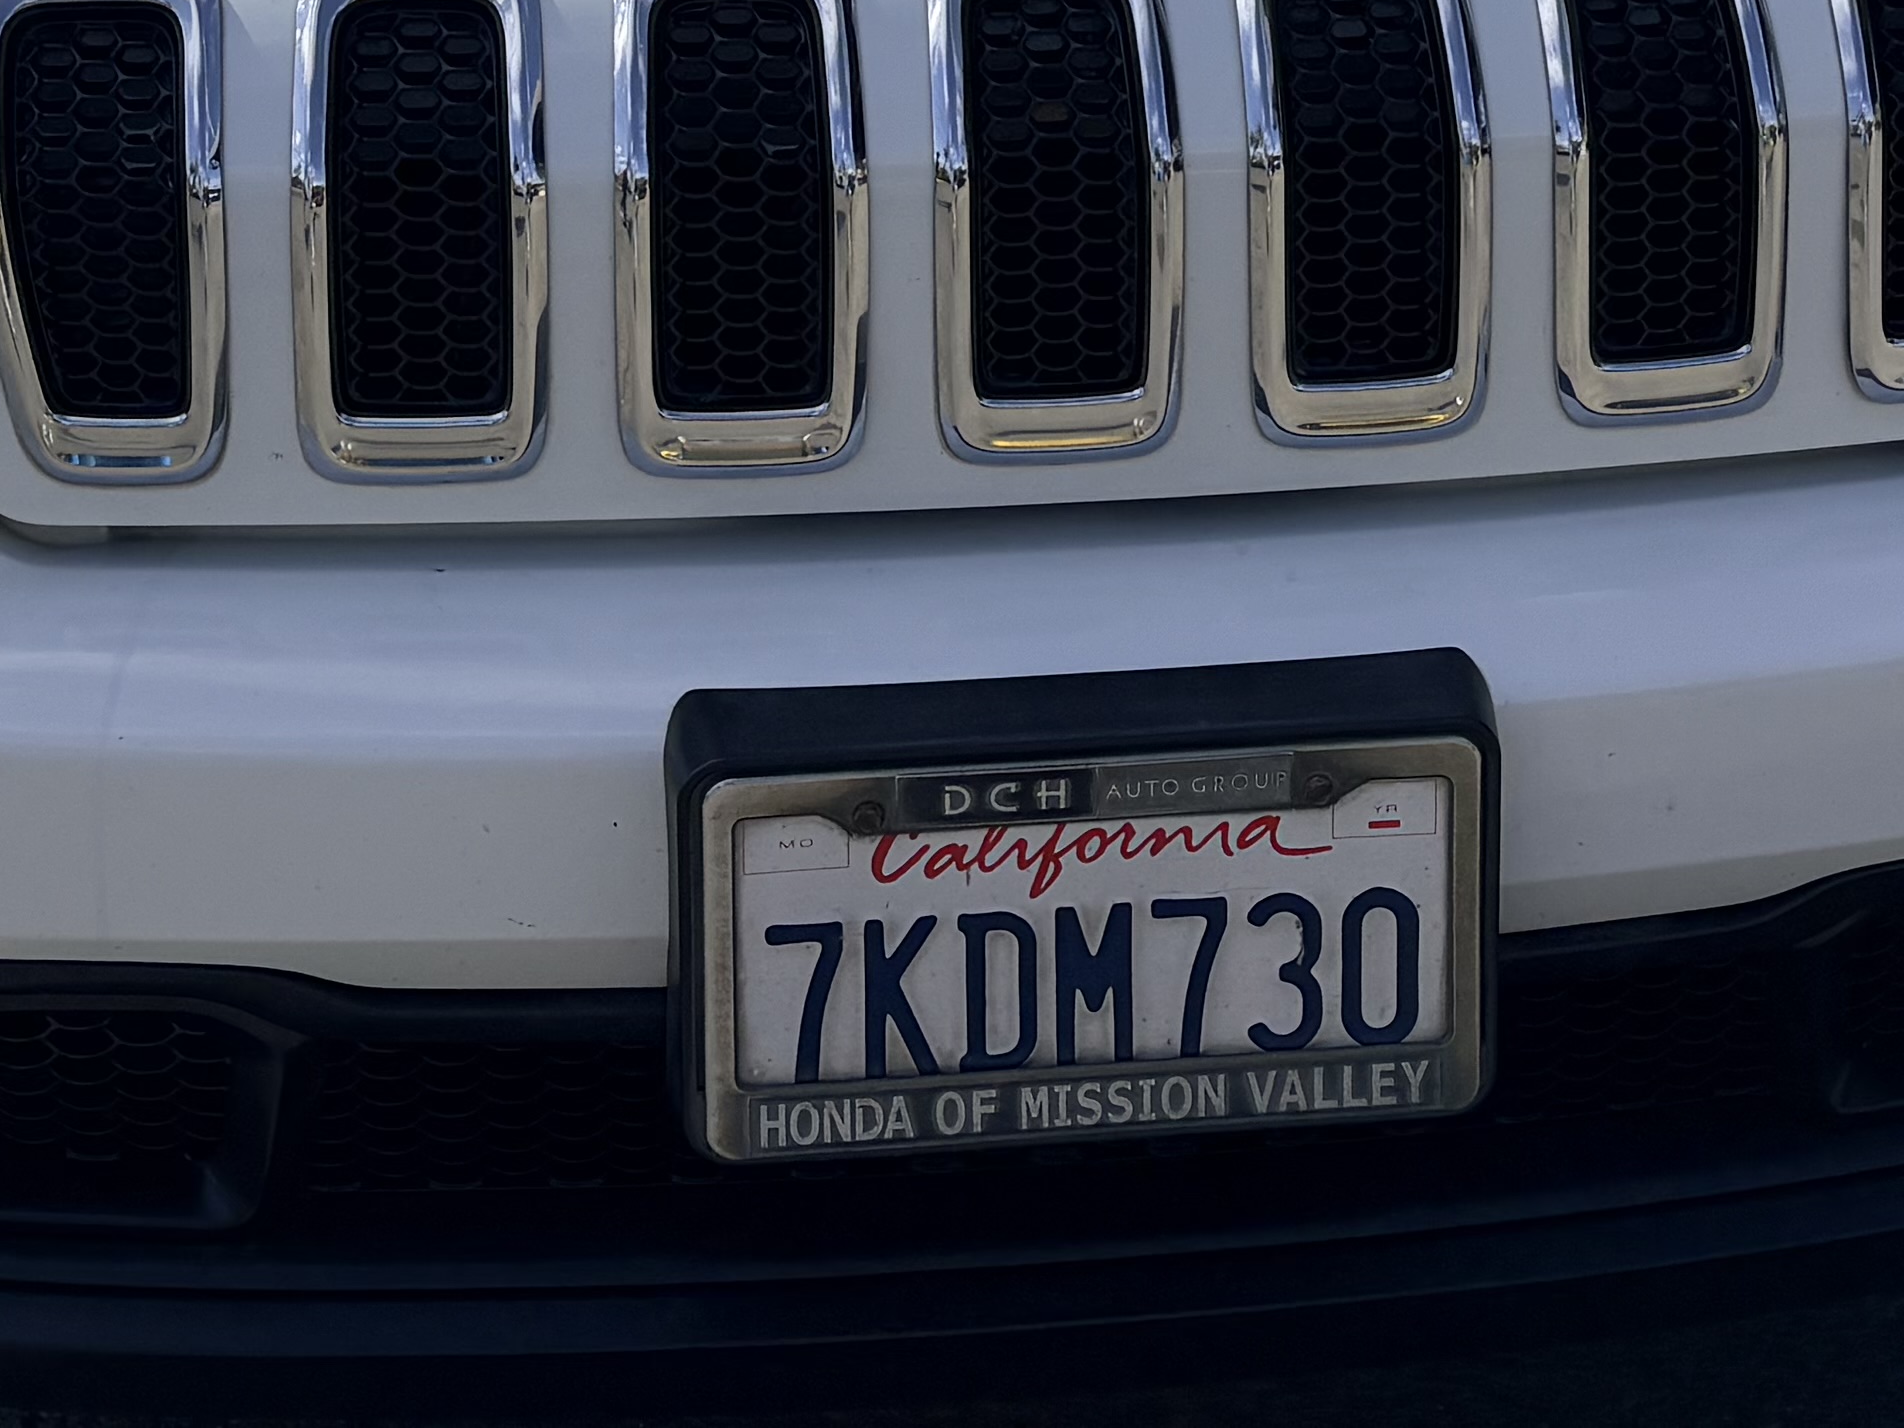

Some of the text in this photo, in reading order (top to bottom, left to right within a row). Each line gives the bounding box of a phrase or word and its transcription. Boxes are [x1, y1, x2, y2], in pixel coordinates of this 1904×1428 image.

[943, 771, 1287, 815] DCH AUTO GROUP
[779, 838, 814, 849] MO
[871, 814, 1332, 899] California
[764, 886, 1420, 1084] 7KDM730
[759, 1060, 1431, 1148] HONDA OF MISSION VALLEY
